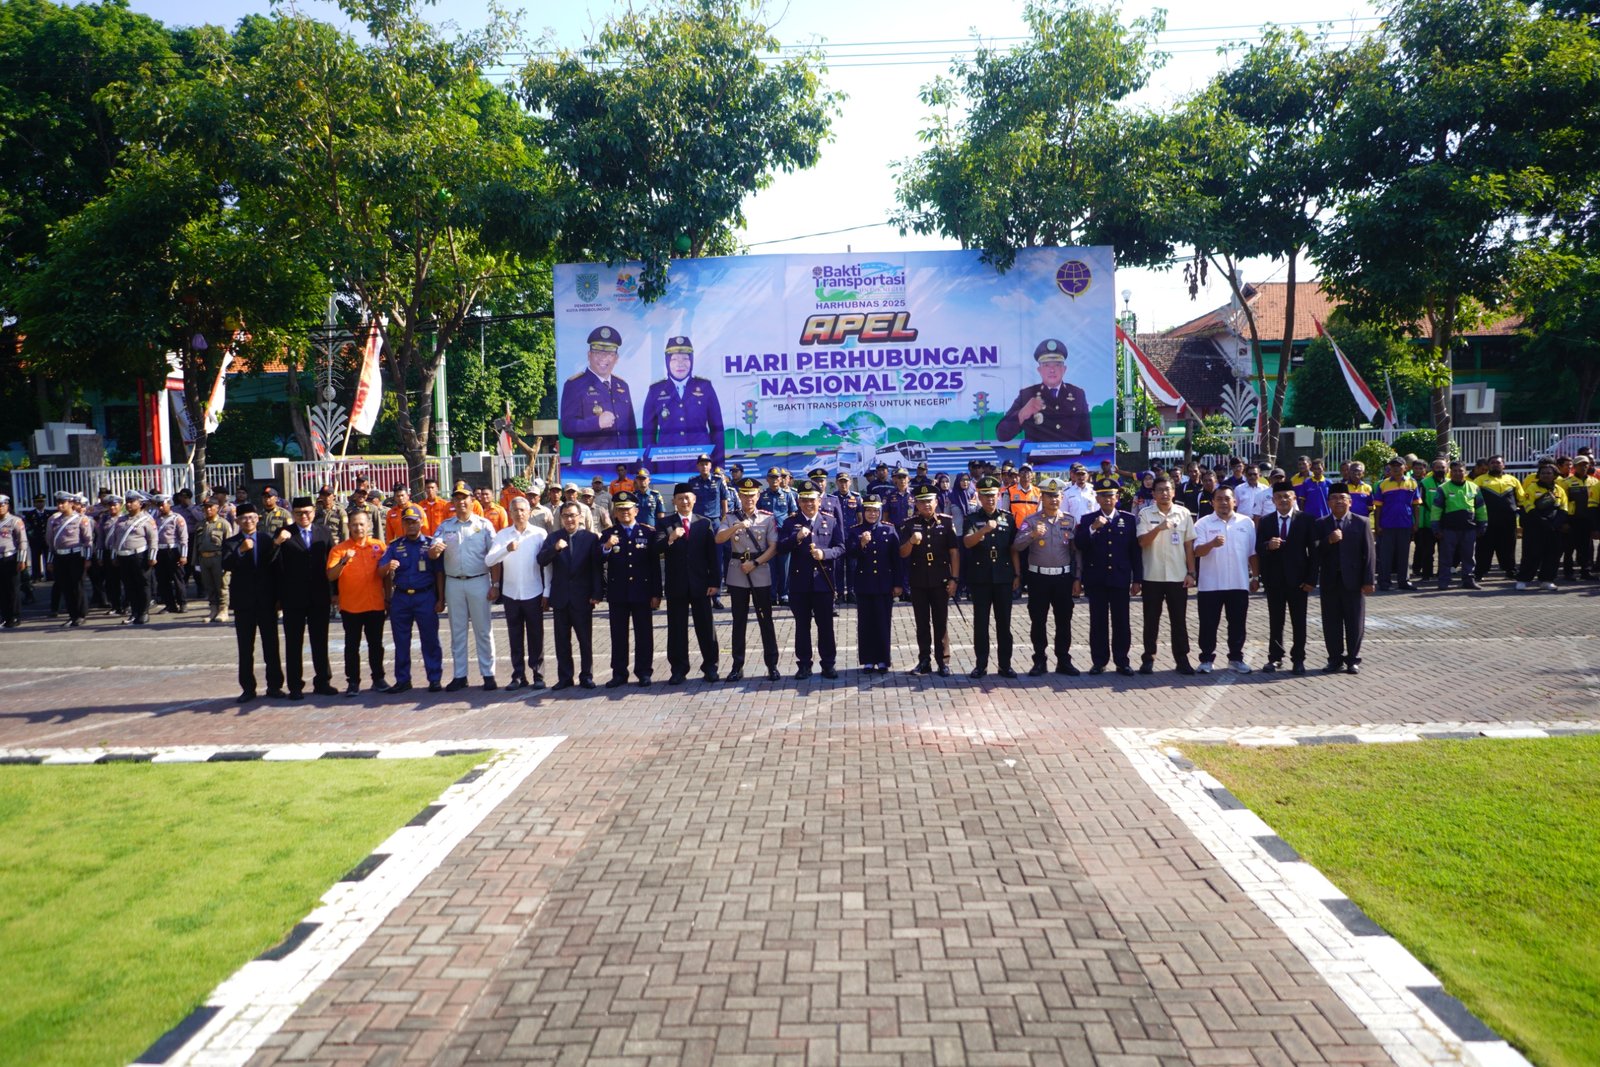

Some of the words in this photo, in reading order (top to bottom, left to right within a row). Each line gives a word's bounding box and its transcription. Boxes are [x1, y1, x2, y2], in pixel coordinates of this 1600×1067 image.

[823, 264, 861, 278] Bakti
[812, 272, 905, 289] Transportasi
[815, 301, 880, 310] HARHUBNAS
[799, 311, 919, 345] APEL
[724, 353, 788, 374] HARI
[796, 346, 998, 371] PERHUBUNGAN
[761, 373, 897, 396] NASIONAL
[902, 371, 964, 391] 2025
[807, 400, 877, 410] TRANSPORTASI
[880, 399, 911, 408] UNTUK
